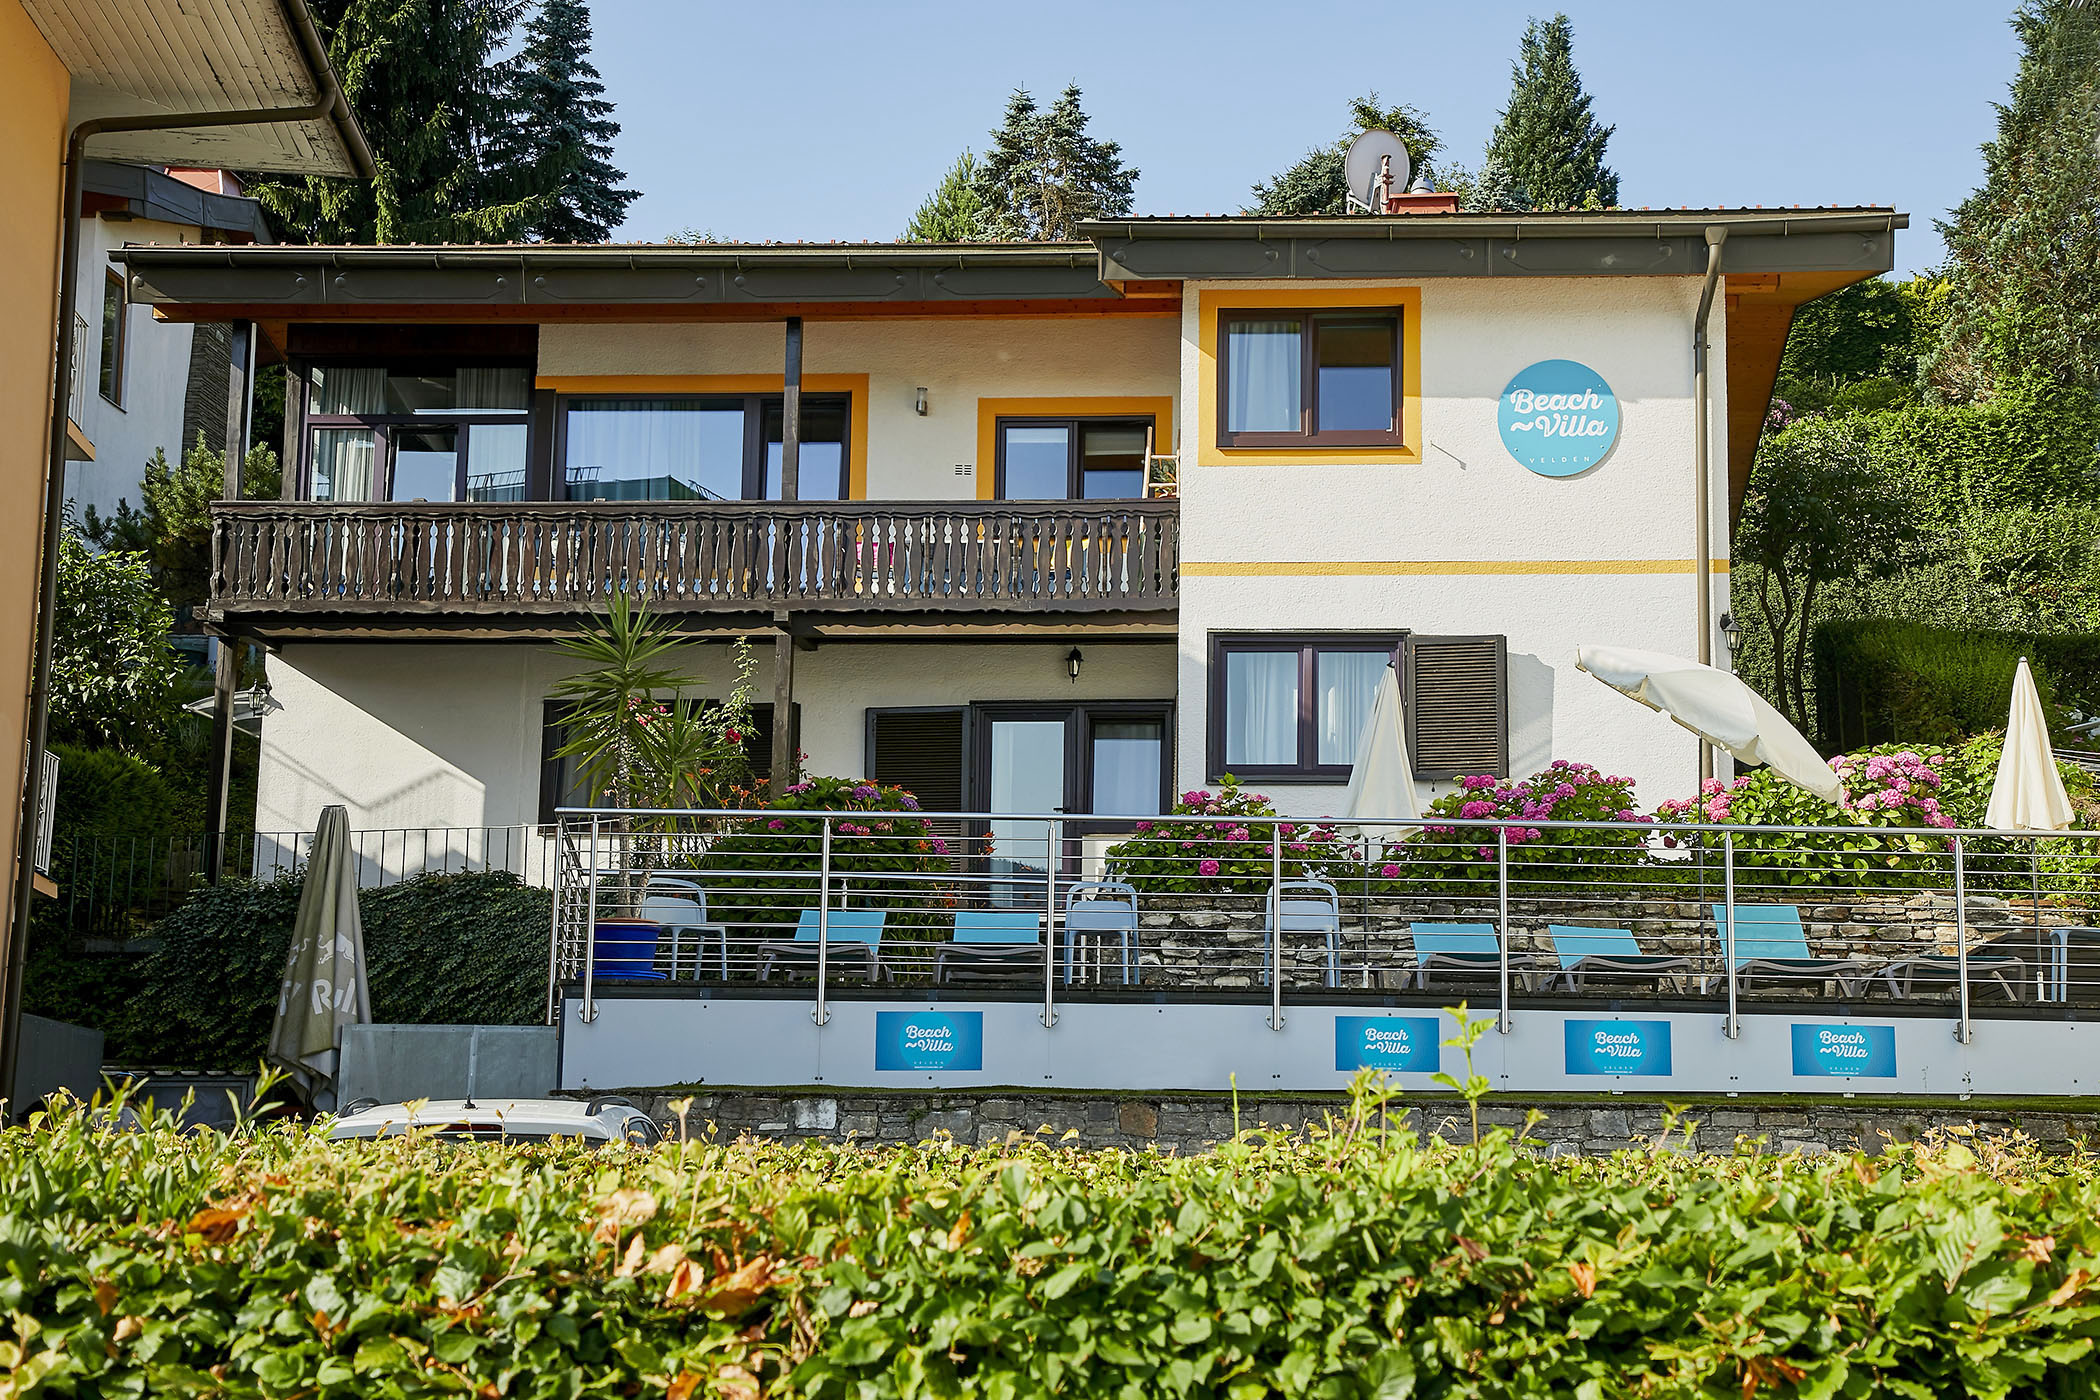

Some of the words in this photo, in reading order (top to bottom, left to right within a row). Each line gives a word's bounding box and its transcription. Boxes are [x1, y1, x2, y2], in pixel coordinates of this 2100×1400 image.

[1510, 388, 1604, 414] Beach
[1534, 413, 1609, 438] Villa
[1529, 456, 1591, 464] VELDEN
[905, 1024, 952, 1040] Beach
[1365, 1027, 1409, 1042] Beach
[1594, 1031, 1640, 1045] Beach
[1819, 1030, 1866, 1045] Beach
[917, 1038, 954, 1052] Villa
[1376, 1041, 1412, 1054] Villa
[1606, 1044, 1643, 1058] Villa
[1831, 1043, 1869, 1058] Villa
